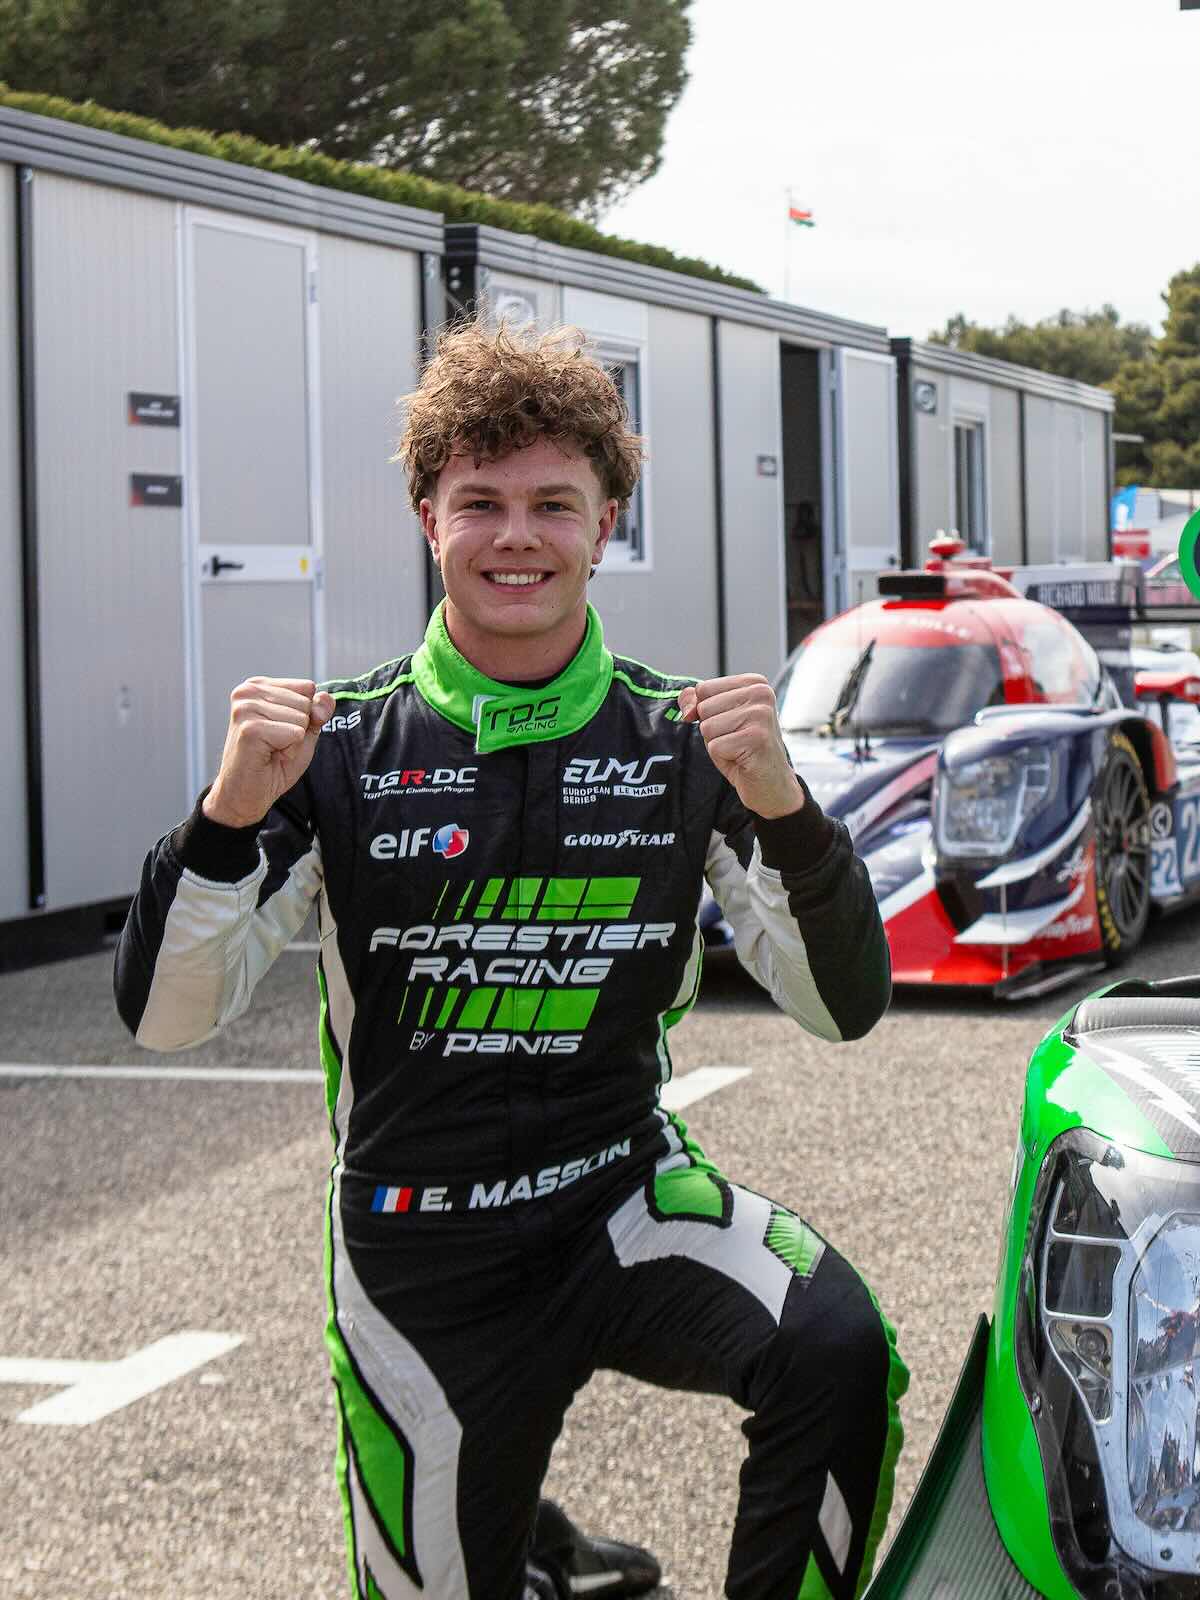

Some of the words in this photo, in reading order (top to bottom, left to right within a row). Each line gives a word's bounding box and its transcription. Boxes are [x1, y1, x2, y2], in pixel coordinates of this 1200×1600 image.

[485, 696, 561, 731] TDS
[360, 767, 478, 790] TGR-DC
[443, 785, 475, 793] Program
[563, 786, 610, 796] EUROPEAN
[563, 795, 597, 804] SERIES
[370, 828, 431, 860] elf
[564, 829, 676, 848] GOODYEAR
[369, 922, 676, 952] FORESTIER
[408, 957, 614, 984] RACING
[409, 1031, 437, 1051] BY
[419, 1186, 453, 1212] E.
[468, 1137, 631, 1209] MASSON
